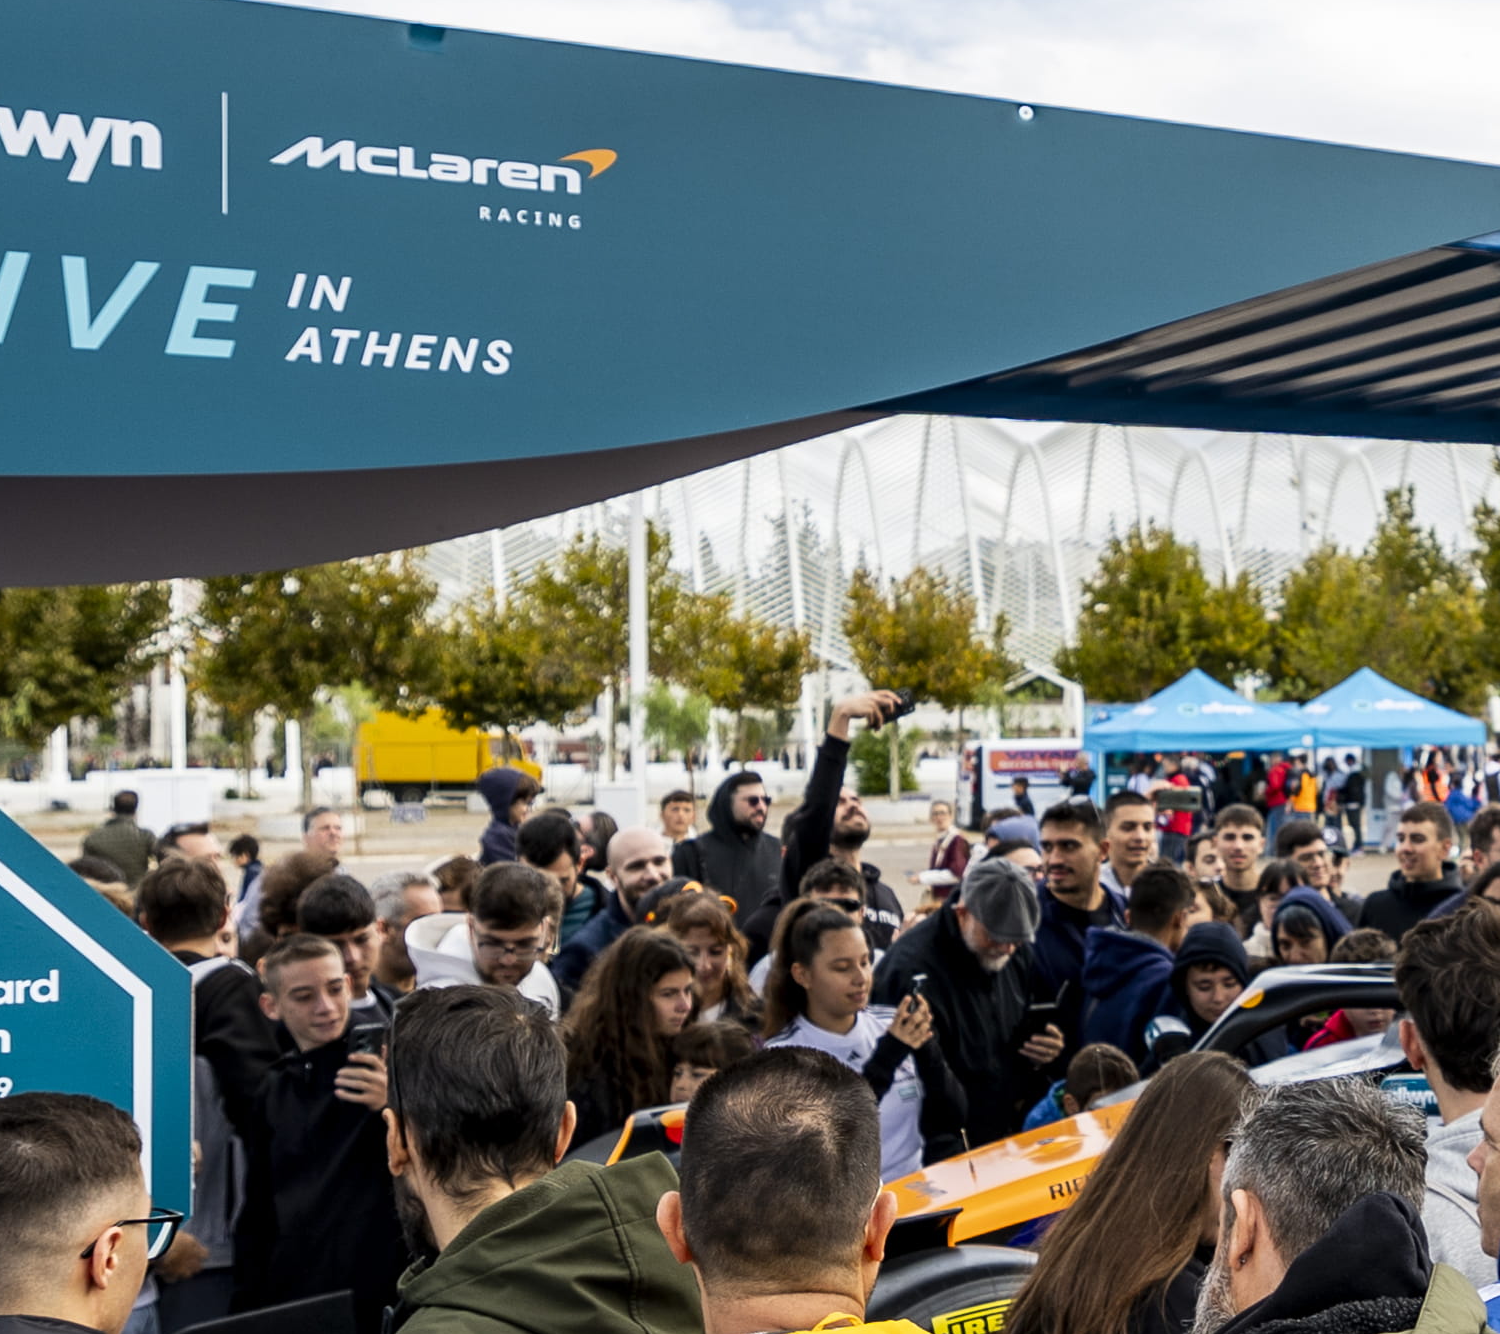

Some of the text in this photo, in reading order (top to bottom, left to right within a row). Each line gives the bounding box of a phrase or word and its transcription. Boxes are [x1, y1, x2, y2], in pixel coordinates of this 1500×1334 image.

[269, 135, 582, 195] McLaren
[479, 205, 582, 229] RACING
[287, 273, 352, 312] IN
[285, 326, 513, 375] ATHENS
